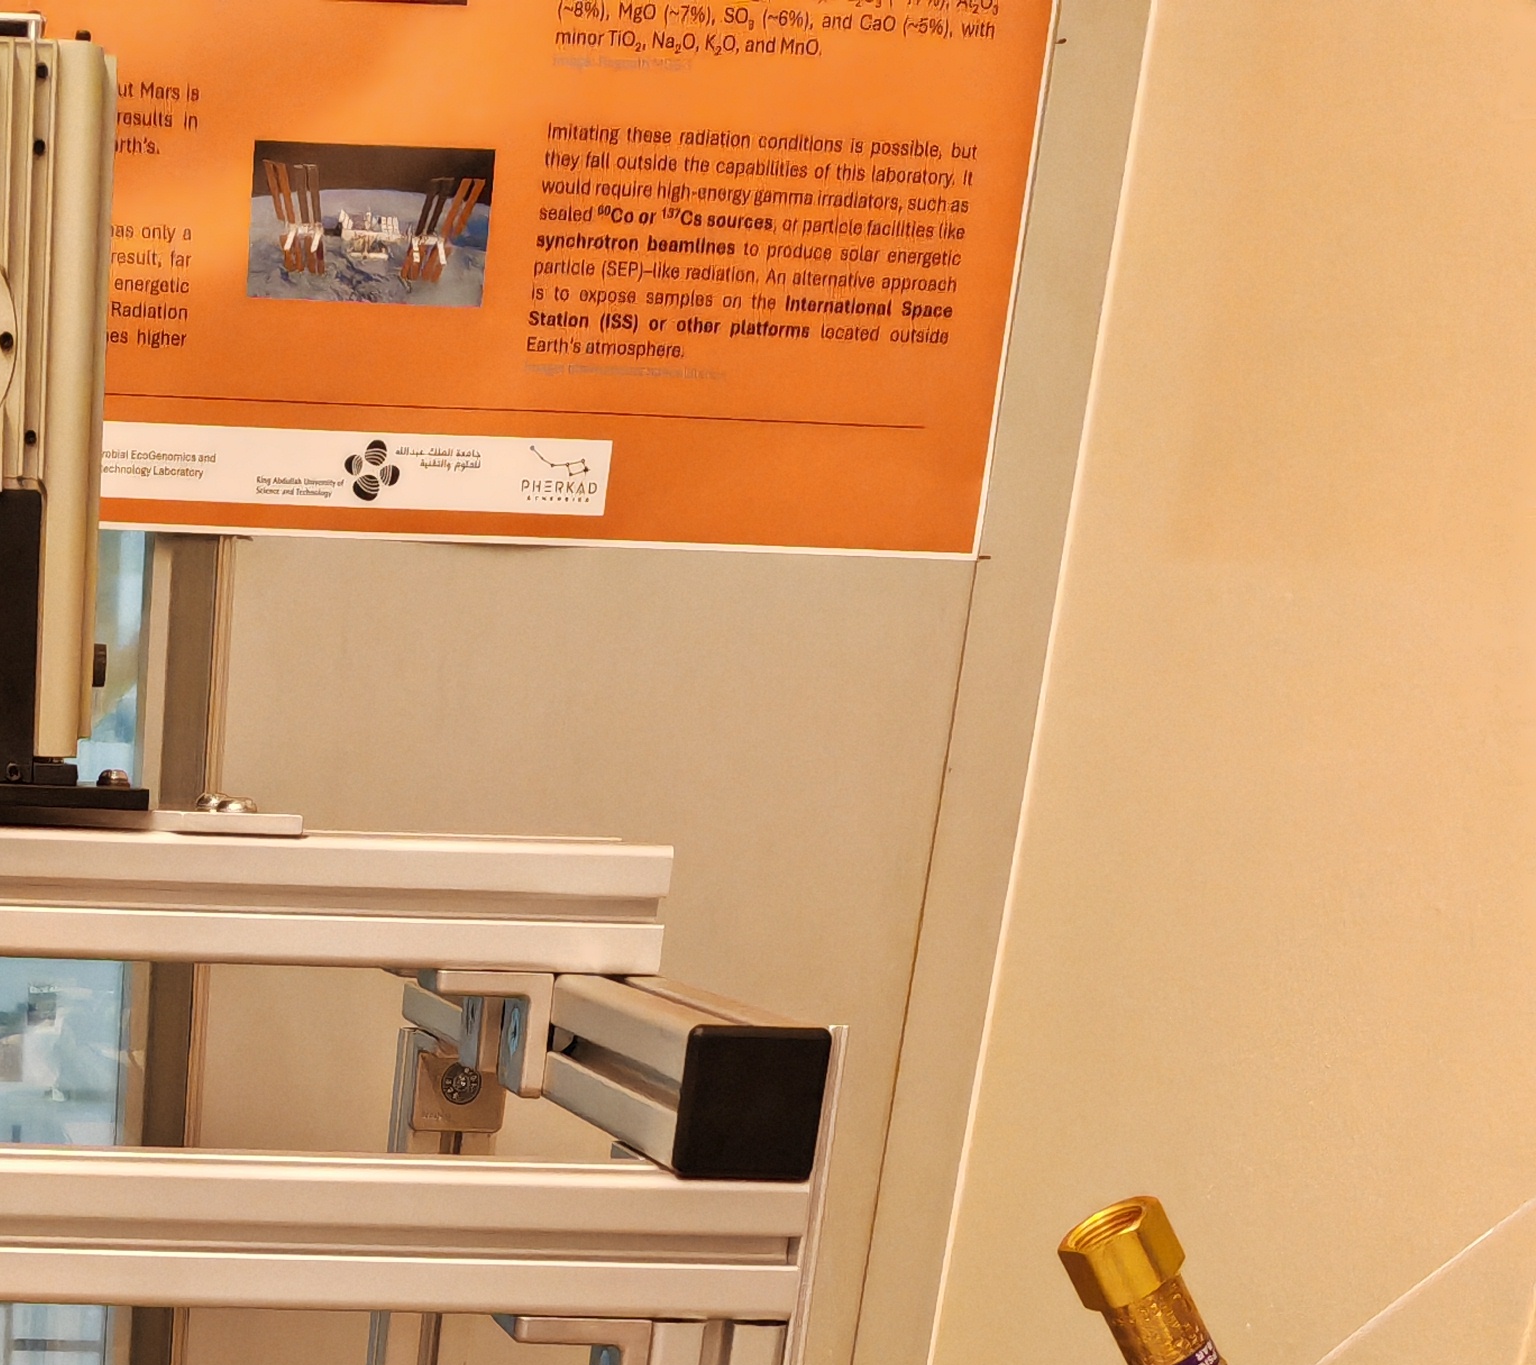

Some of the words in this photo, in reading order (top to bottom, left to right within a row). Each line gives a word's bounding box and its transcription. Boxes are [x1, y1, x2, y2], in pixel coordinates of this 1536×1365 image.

[619, 4, 656, 23] MgO
[822, 14, 852, 30] and
[860, 14, 896, 32] CaO
[962, 19, 996, 39] with
[555, 30, 603, 46] minor
[745, 37, 775, 53] and
[140, 82, 180, 101] Mars
[186, 83, 200, 102] is
[184, 111, 198, 131] in
[547, 122, 621, 145] Imitating
[627, 126, 672, 144] these
[680, 129, 751, 148] radiation
[758, 134, 843, 153] conditions
[851, 138, 863, 154] is
[870, 139, 942, 160] possible,
[951, 142, 977, 160] but
[545, 151, 580, 171] they
[586, 151, 610, 169] fall
[616, 153, 677, 172] outside
[684, 156, 710, 173] the
[715, 159, 808, 178] capabilities
[814, 163, 831, 180] of
[837, 163, 865, 181] this
[871, 165, 955, 188] laboratory.
[963, 170, 973, 186] It
[542, 179, 591, 196] would
[595, 181, 652, 199] require
[657, 181, 751, 205] high-energy
[754, 189, 813, 207] gamma
[817, 189, 903, 214] irradiators,
[907, 196, 947, 213] such
[950, 199, 969, 214] as
[142, 224, 176, 243] only
[183, 228, 192, 240] a
[539, 205, 593, 222] sealed
[639, 211, 657, 225] or
[707, 213, 777, 231] sources,
[783, 218, 799, 232] or
[802, 216, 862, 237] particle
[867, 219, 934, 238] facilities
[939, 222, 965, 240] like
[111, 250, 162, 268] result,
[170, 250, 192, 268] far
[536, 234, 639, 252] synchrotron
[647, 235, 735, 255] beamlines
[743, 242, 759, 256] to
[767, 243, 832, 262] produce
[840, 247, 880, 262] solar
[888, 247, 962, 268] energetic
[115, 277, 190, 296] energetic
[533, 259, 595, 277] particle
[686, 264, 759, 284] radiation.
[765, 268, 786, 285] An
[792, 270, 875, 289] alternative
[881, 276, 957, 293] approach
[111, 301, 188, 321] Radiation
[532, 284, 544, 300] is
[554, 286, 569, 301] to
[579, 289, 636, 308] expose
[646, 291, 713, 309] samples
[722, 294, 742, 309] on
[752, 294, 775, 310] the
[785, 295, 892, 316] International
[901, 301, 953, 320] Space
[137, 329, 187, 349] higher
[528, 310, 589, 328] Station
[600, 313, 639, 333] (ISS)
[649, 317, 667, 331] or
[676, 317, 721, 334] other
[729, 319, 810, 339] platforms
[821, 323, 880, 341] located
[890, 327, 949, 345] outside
[527, 336, 581, 354] Earth's
[586, 340, 684, 360] atmosphere.
[130, 450, 196, 462] EcoGenomics
[198, 453, 216, 463] and
[153, 466, 203, 479] Laboratory
